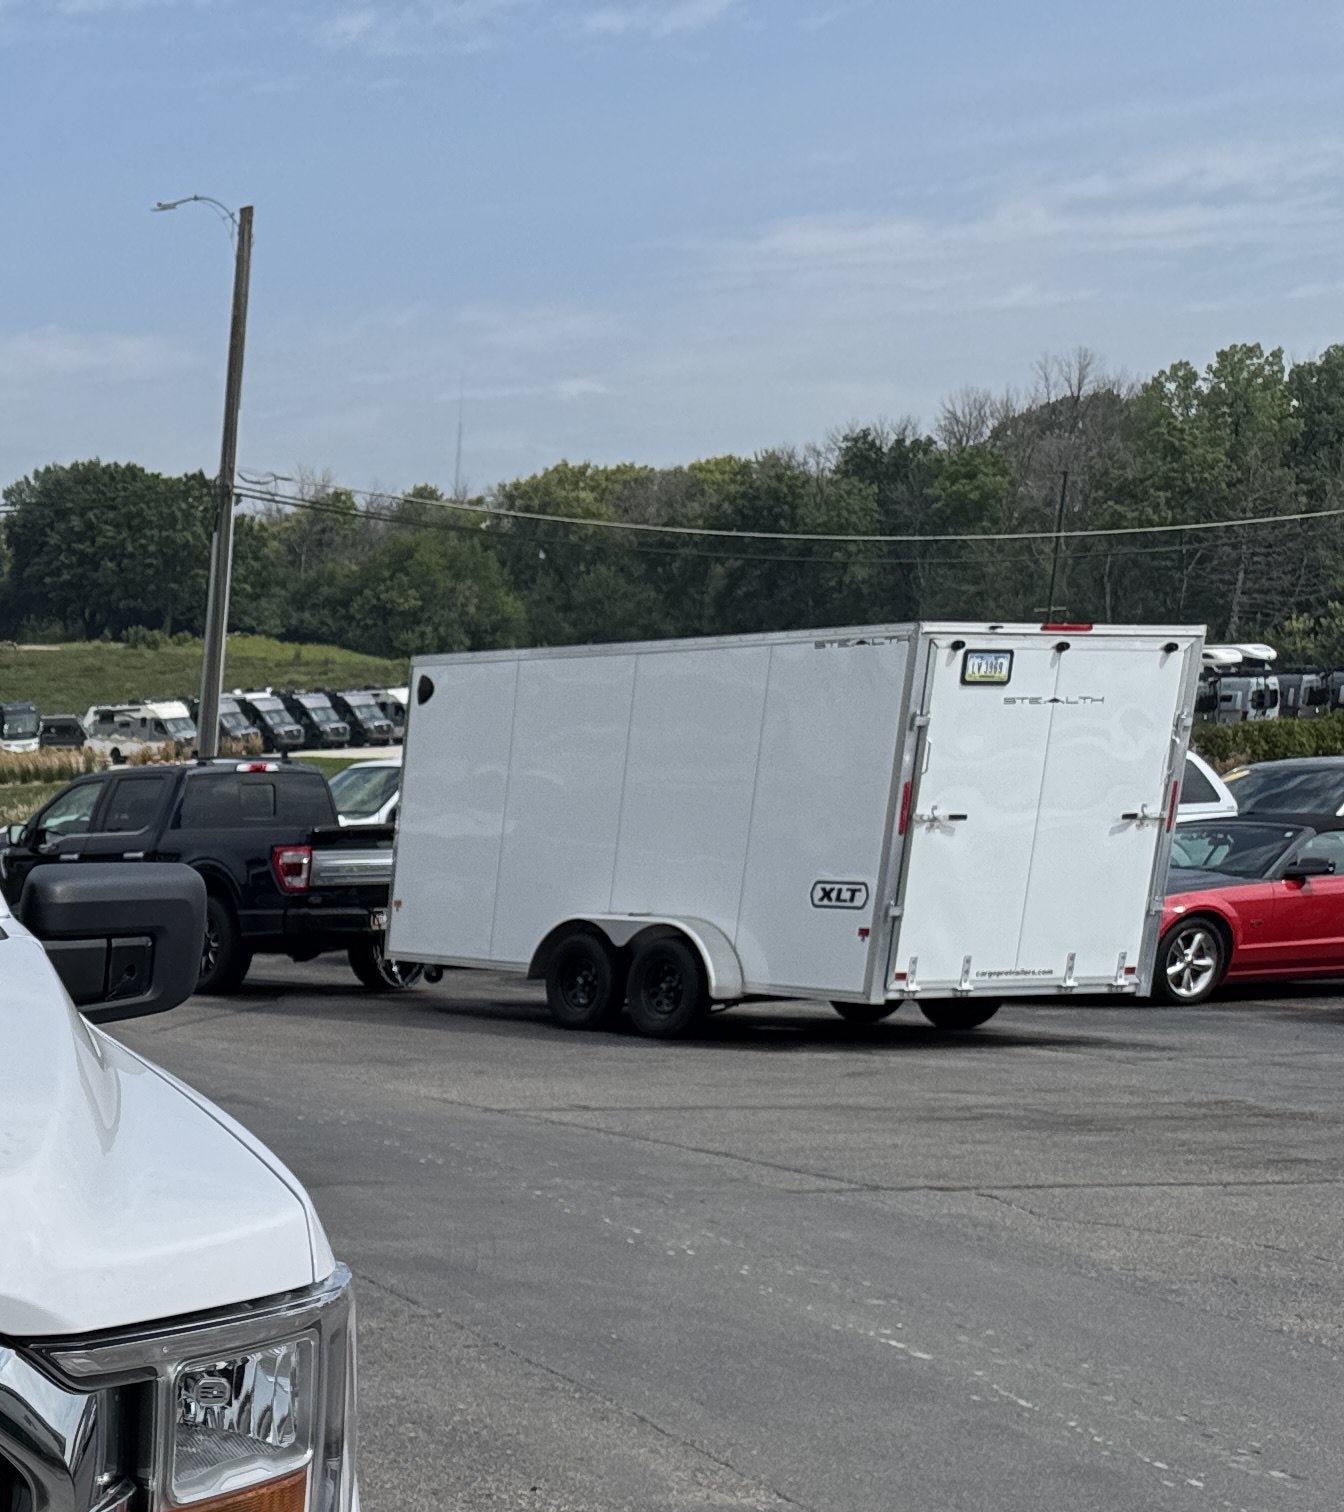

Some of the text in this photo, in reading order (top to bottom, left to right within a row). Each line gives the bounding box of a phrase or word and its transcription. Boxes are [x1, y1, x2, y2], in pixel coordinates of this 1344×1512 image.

[814, 636, 910, 649] STEALTH
[1003, 696, 1105, 705] STEALTH
[818, 887, 862, 903] XLT
